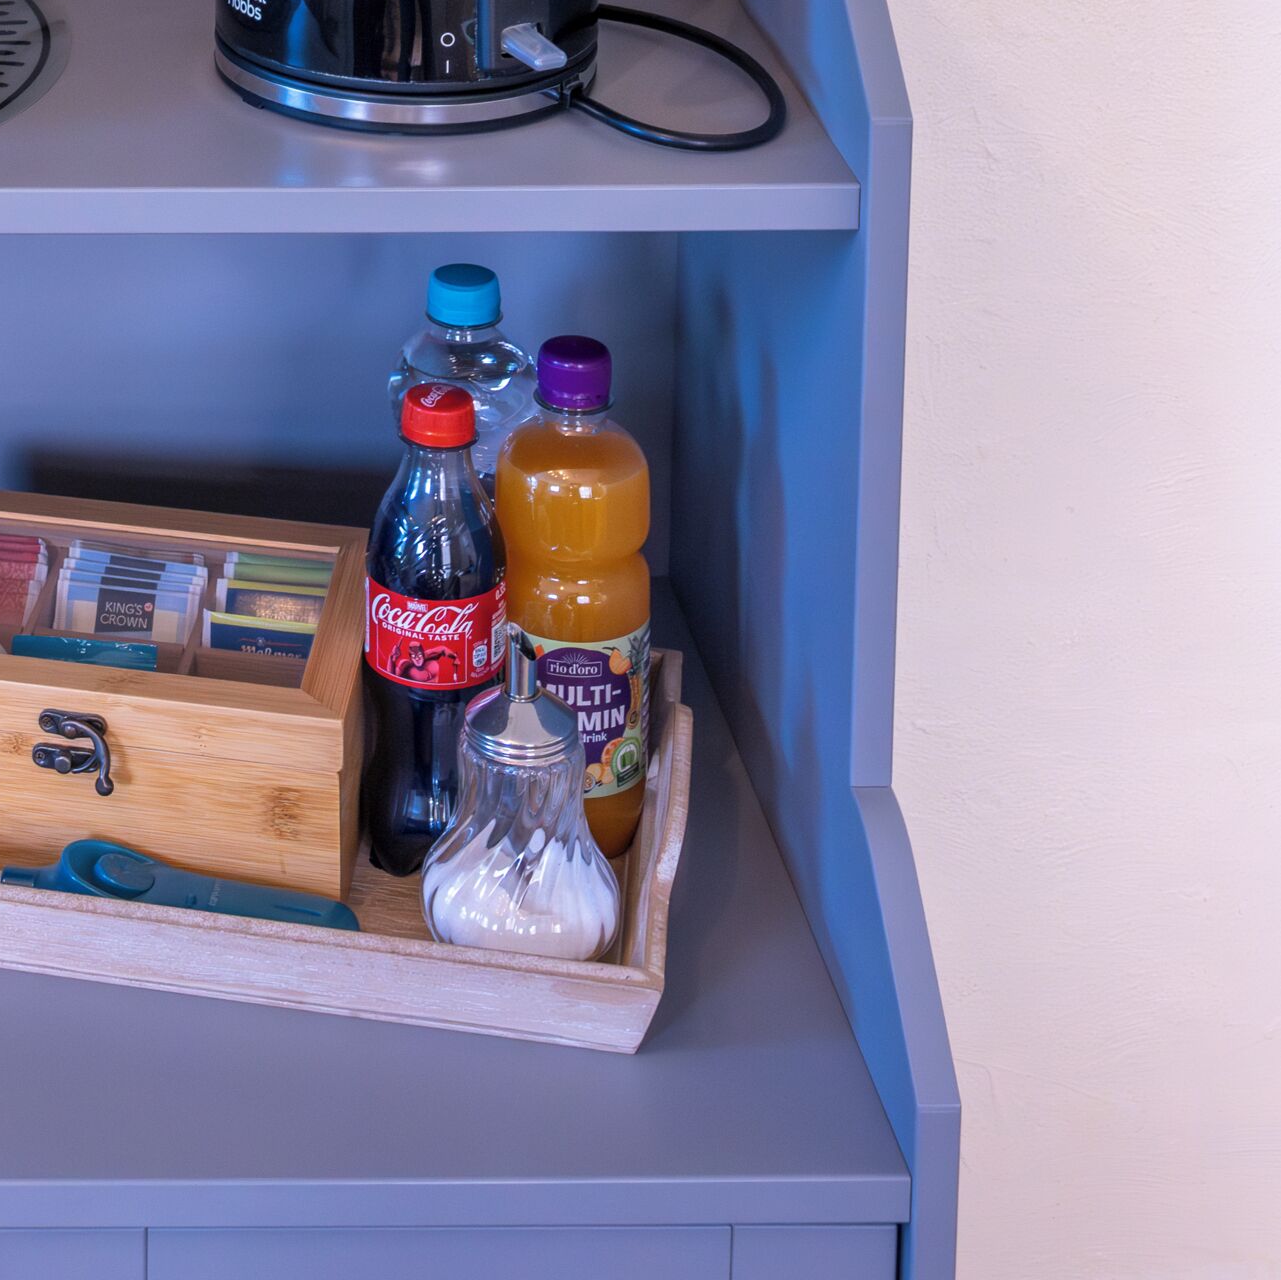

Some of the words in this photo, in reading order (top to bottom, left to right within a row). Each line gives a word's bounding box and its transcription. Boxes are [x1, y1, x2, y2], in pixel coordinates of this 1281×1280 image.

[104, 601, 143, 616] KING'S
[371, 593, 479, 637] Coca-Cola
[99, 613, 148, 629] CROWN
[381, 621, 424, 640] ORIGINAL
[427, 633, 461, 641] TASTE
[549, 661, 567, 673] rio
